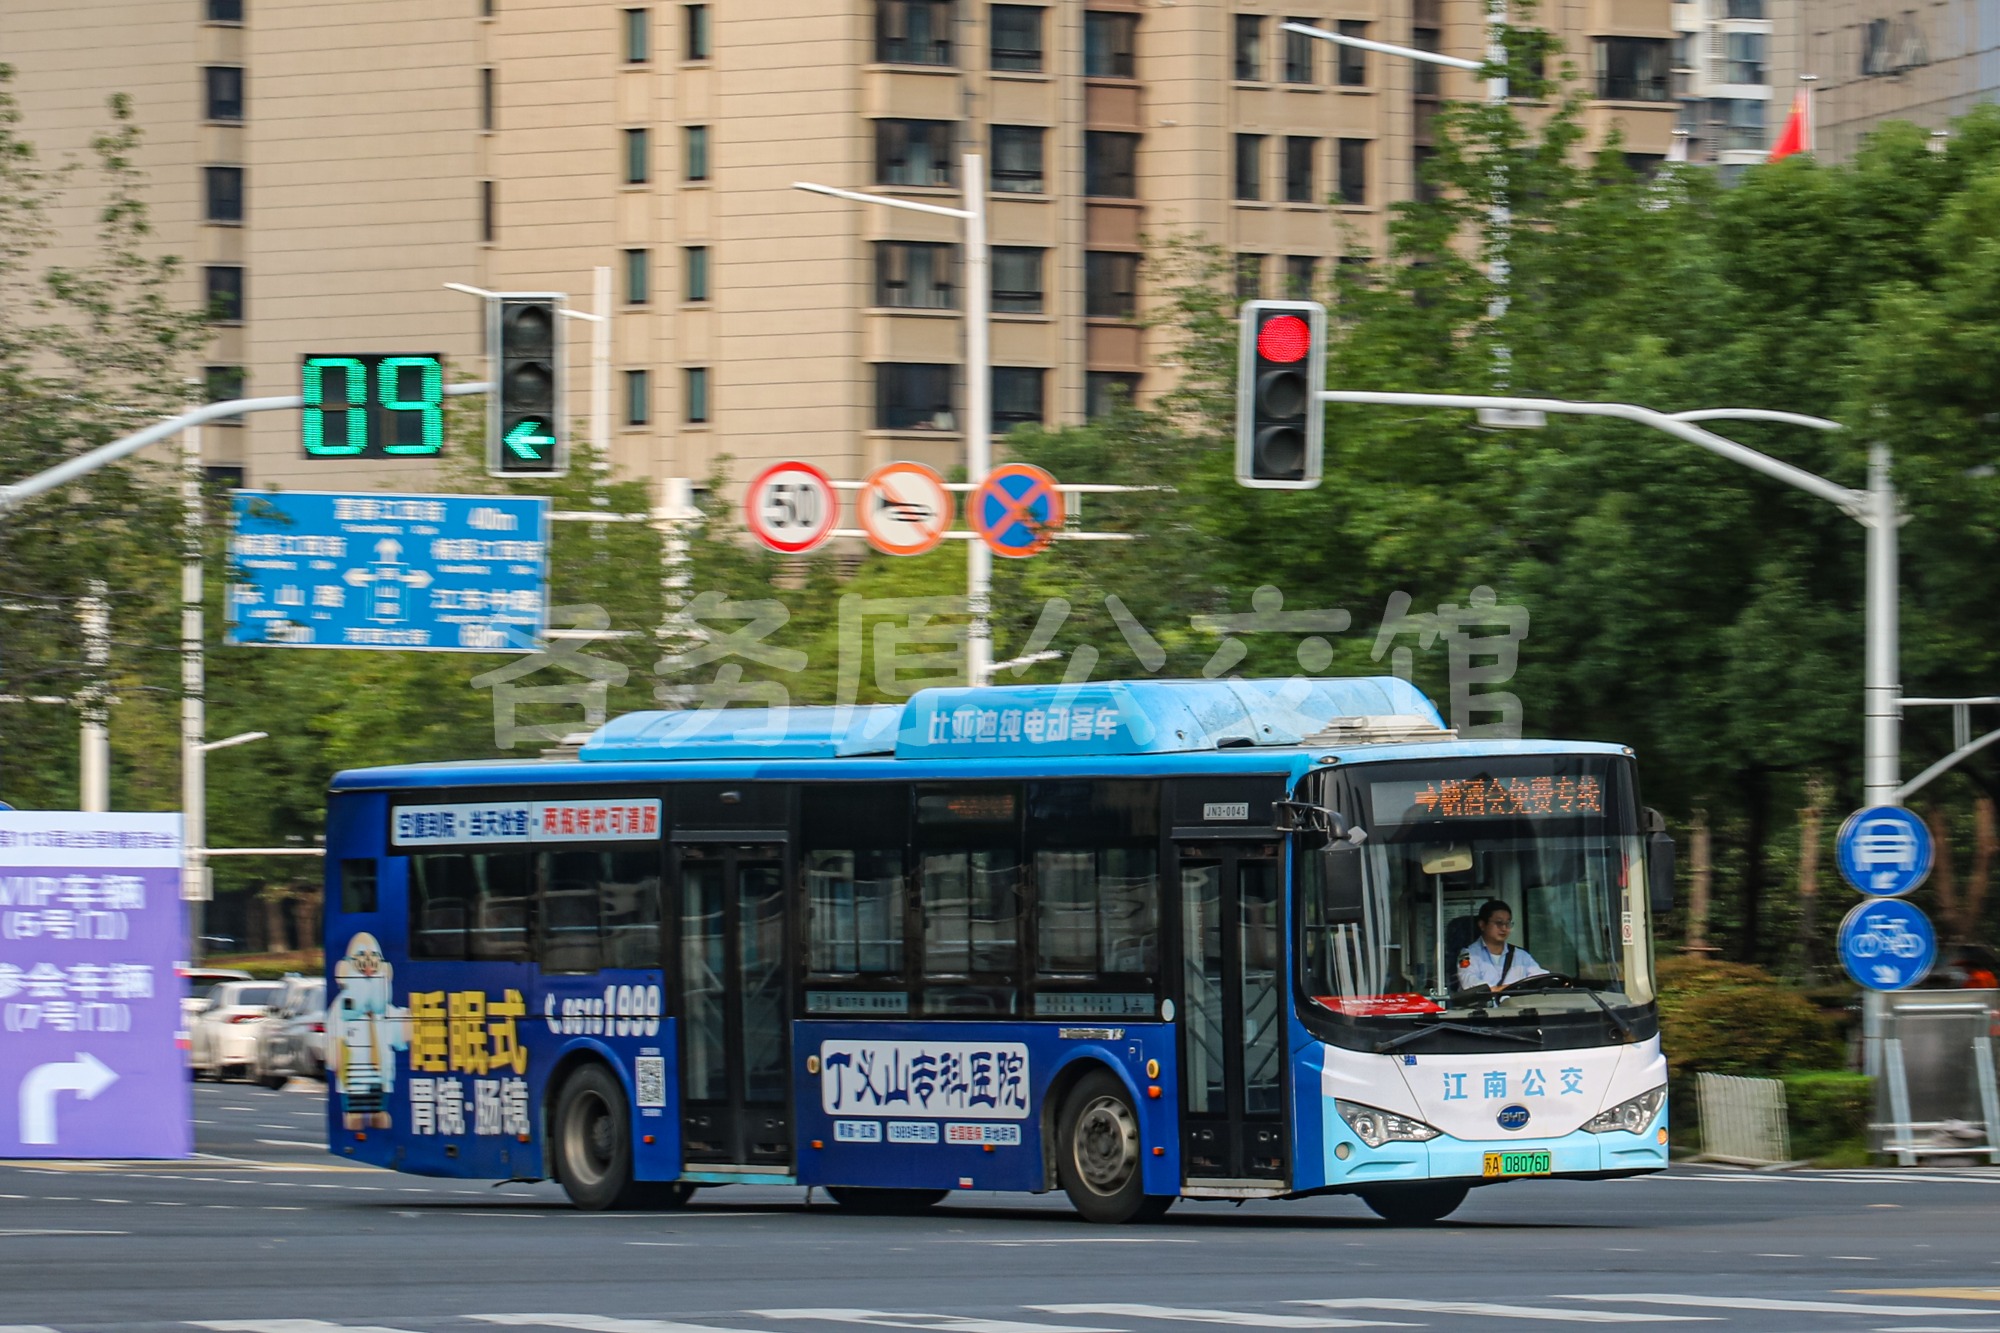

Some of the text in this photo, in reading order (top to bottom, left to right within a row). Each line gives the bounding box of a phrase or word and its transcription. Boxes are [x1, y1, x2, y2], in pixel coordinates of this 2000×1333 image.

[302, 357, 444, 455] 09
[766, 484, 816, 528] 50
[928, 707, 1119, 744] 比亚迪纯电动客车
[408, 989, 528, 1075] 睡眠式
[826, 1048, 1026, 1110] 丁义山专科医院
[1443, 1066, 1584, 1101] 江南公交
[1501, 1111, 1528, 1123] BYD
